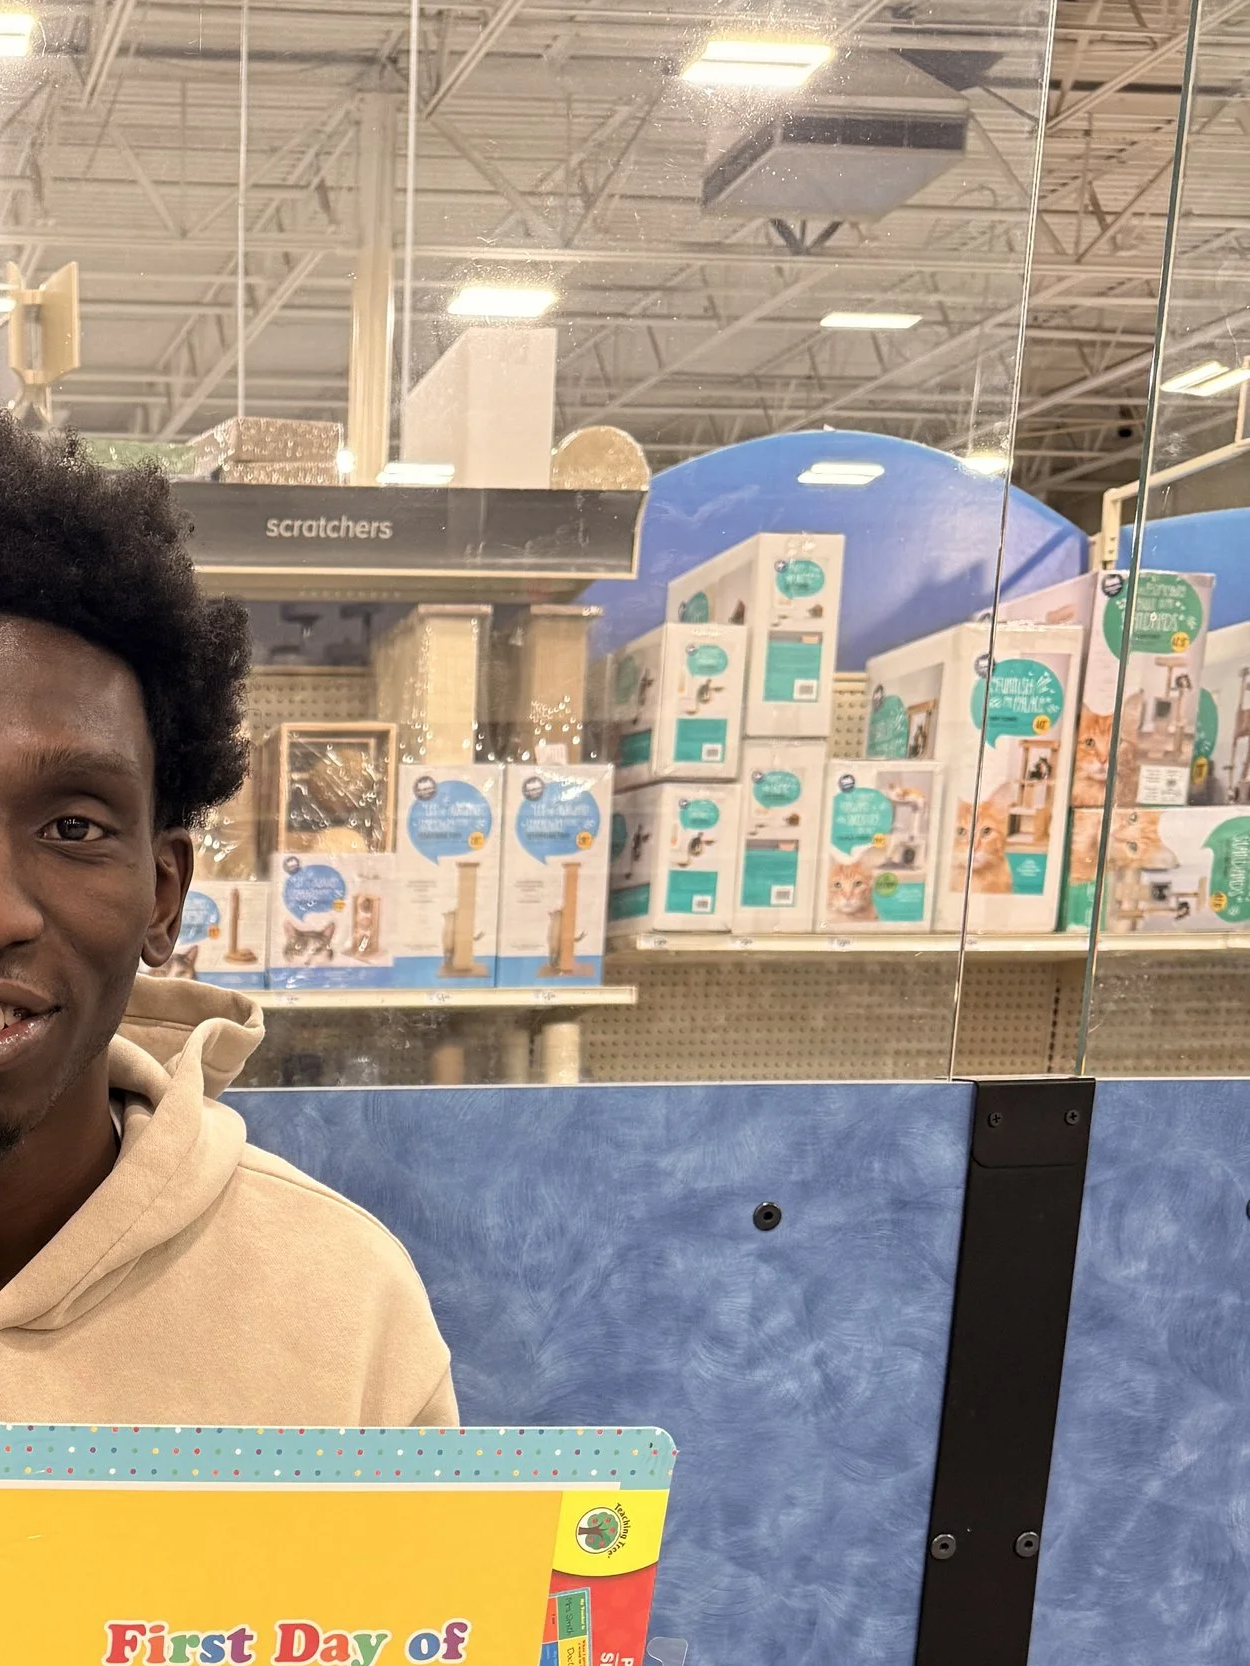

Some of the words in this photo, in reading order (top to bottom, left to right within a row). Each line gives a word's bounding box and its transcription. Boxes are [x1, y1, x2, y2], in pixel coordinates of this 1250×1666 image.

[265, 514, 393, 539] scratchers
[614, 1502, 632, 1540] Teaching
[607, 1541, 627, 1557] Tree
[104, 1622, 255, 1666] First
[406, 1620, 470, 1662] of
